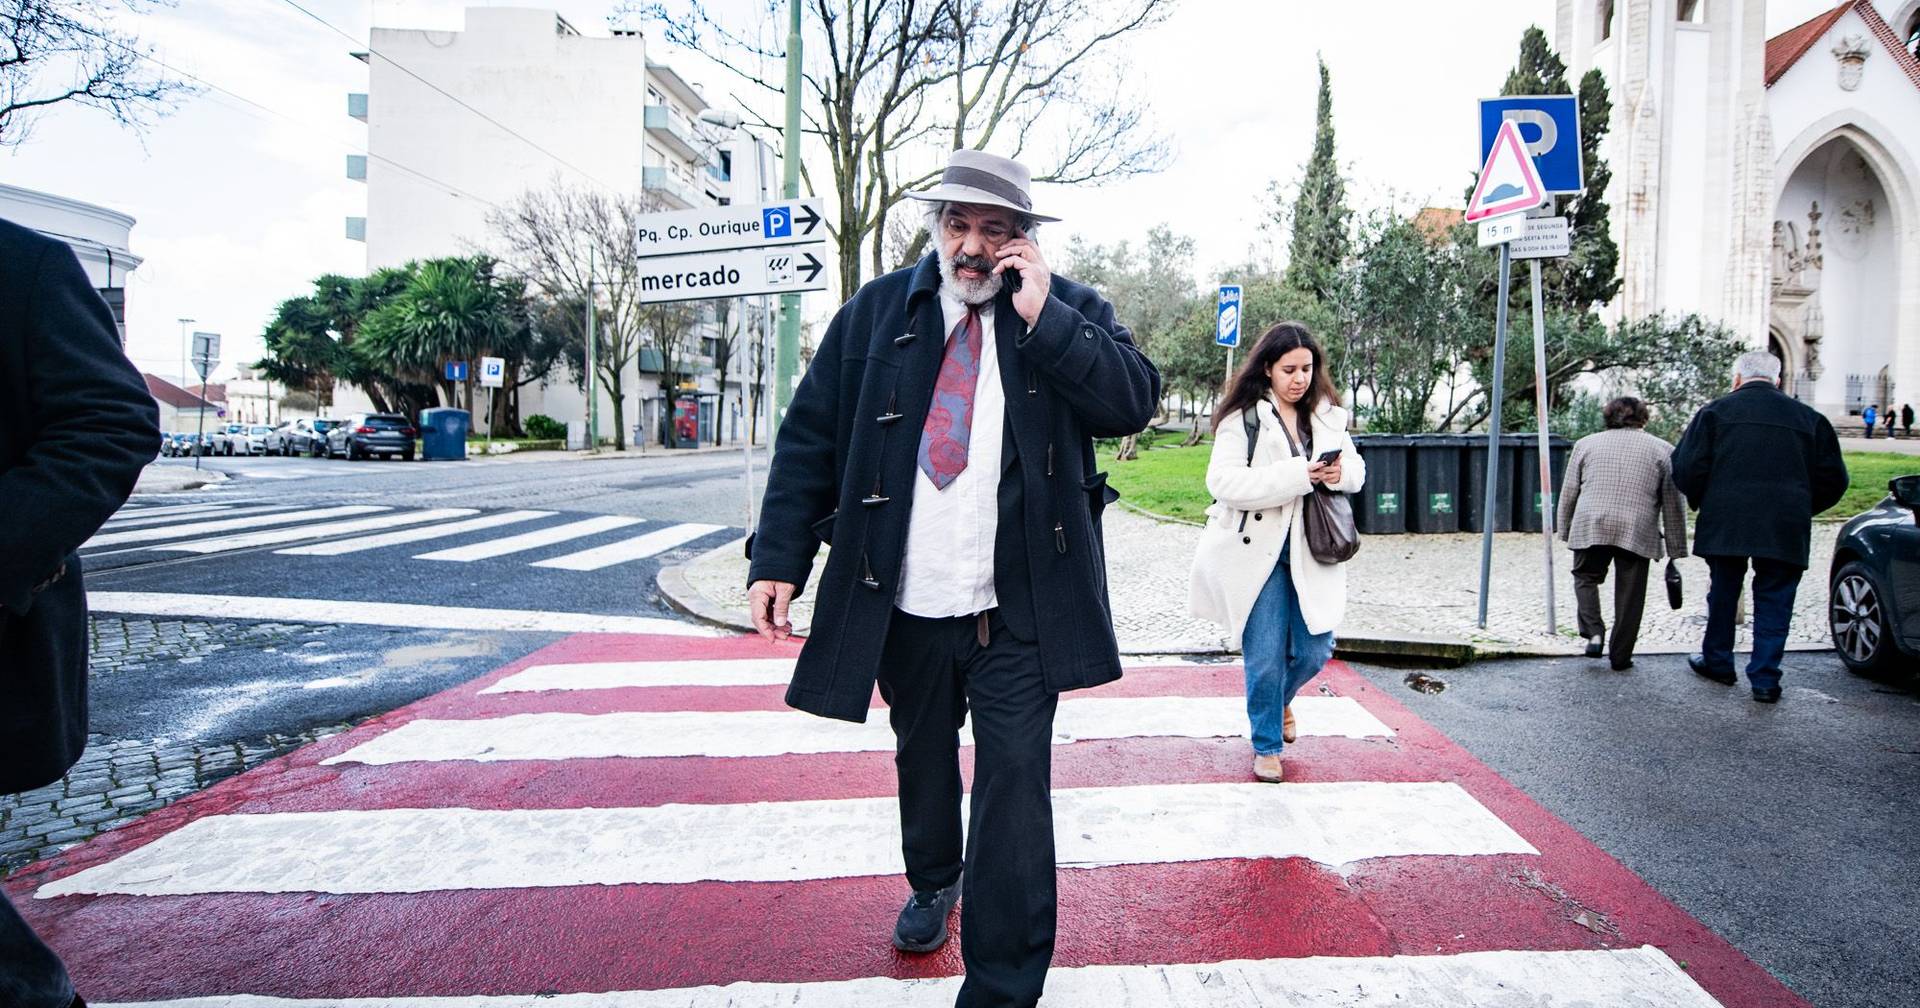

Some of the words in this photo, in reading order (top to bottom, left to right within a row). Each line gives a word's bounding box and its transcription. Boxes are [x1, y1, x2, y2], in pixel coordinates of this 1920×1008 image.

[638, 228, 662, 243] Pq.
[667, 225, 693, 240] Cp.
[699, 220, 760, 236] Ourique
[769, 213, 784, 236] P
[1487, 225, 1497, 237] 15
[1503, 225, 1512, 236] m
[641, 264, 740, 292] mercado
